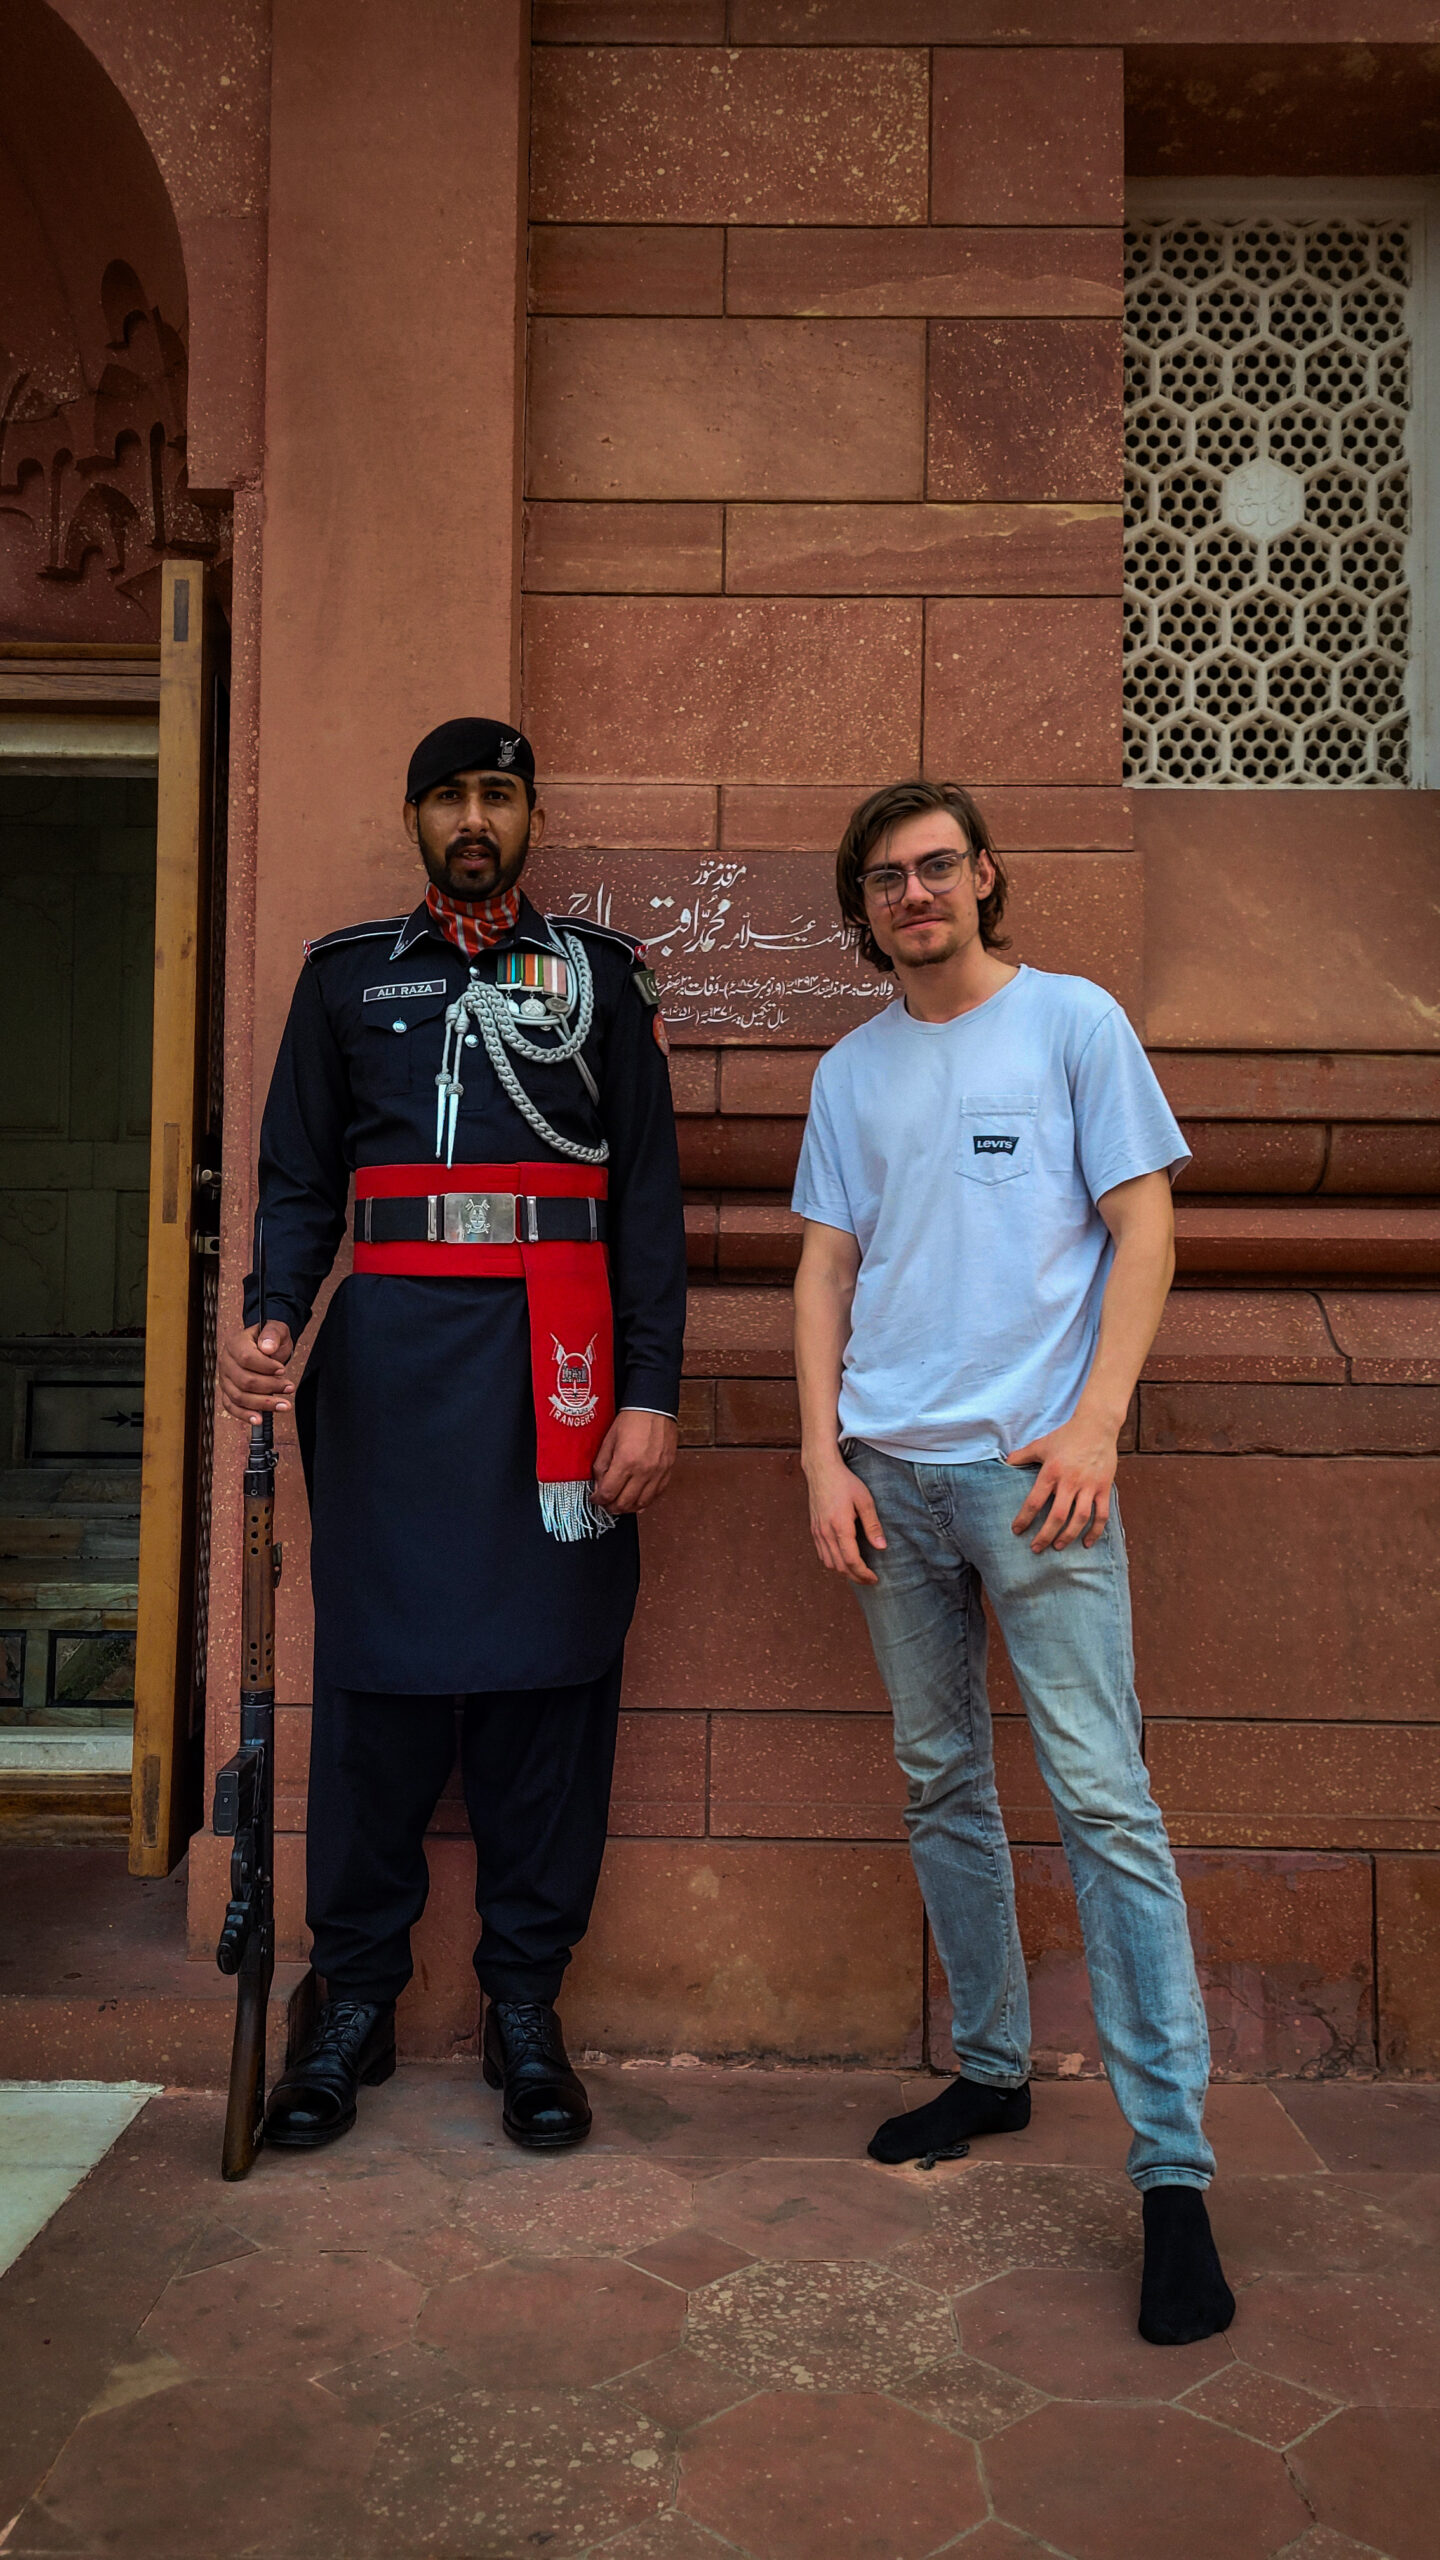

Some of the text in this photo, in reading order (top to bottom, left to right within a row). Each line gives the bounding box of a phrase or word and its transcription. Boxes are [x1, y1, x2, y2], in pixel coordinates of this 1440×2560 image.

[377, 984, 433, 997] ALI RAZA
[552, 1410, 595, 1427] RANGERS
